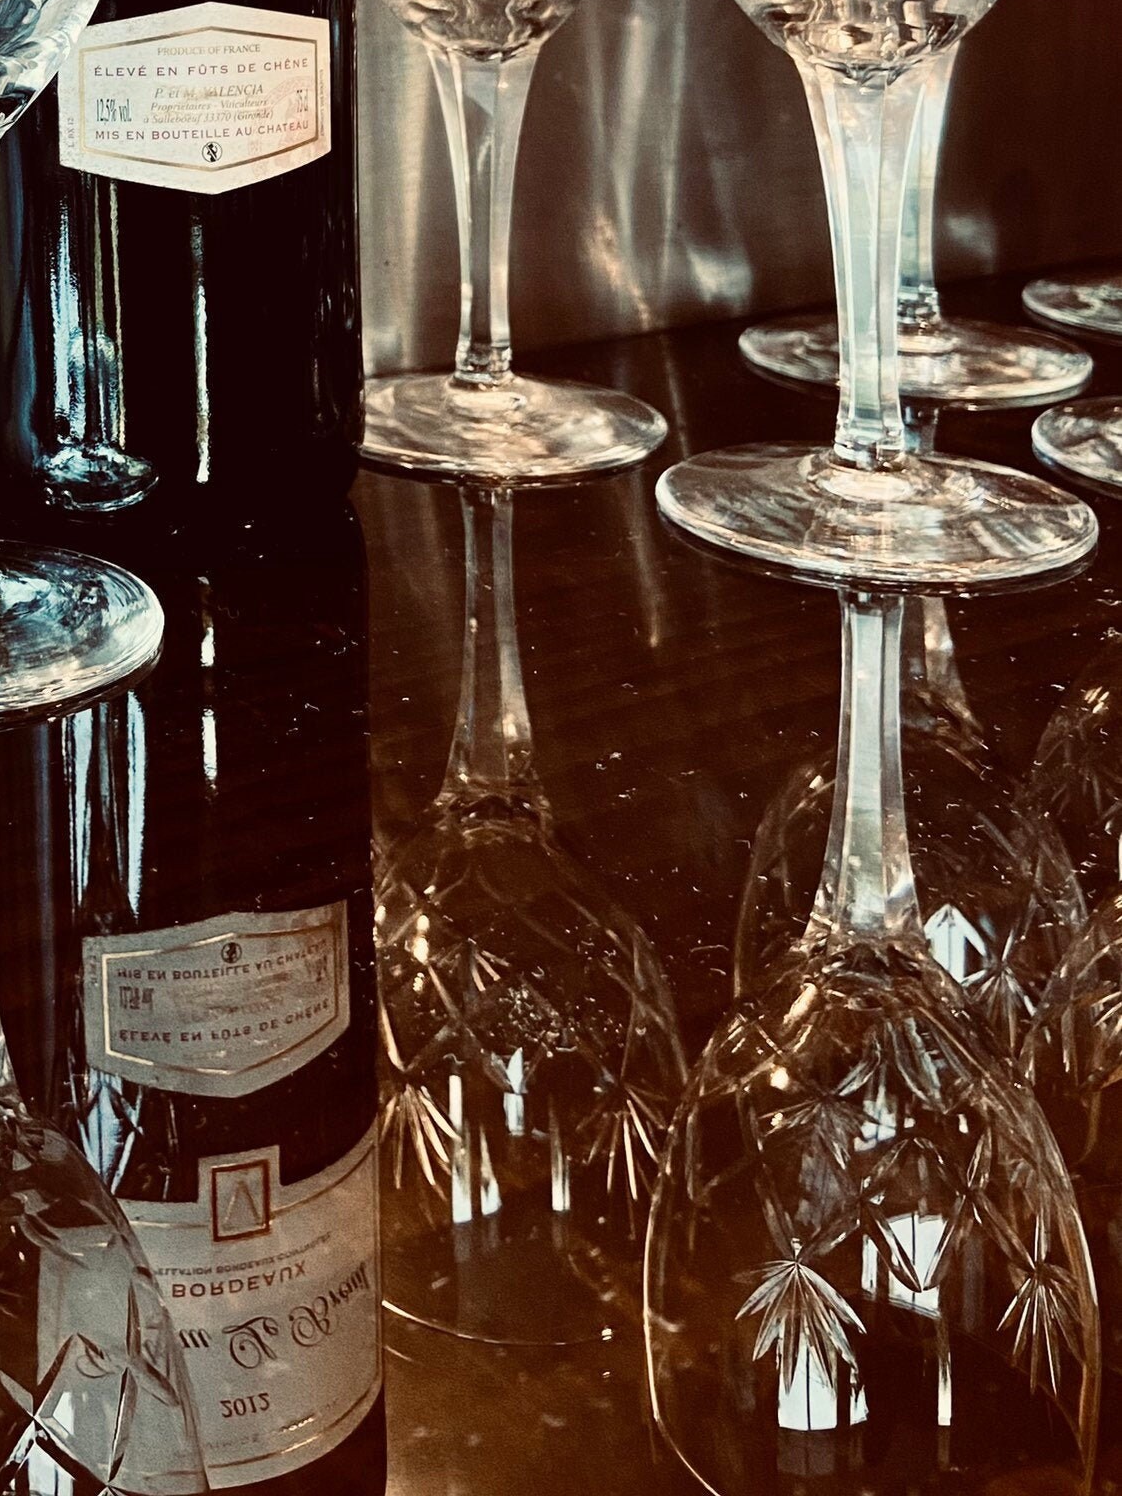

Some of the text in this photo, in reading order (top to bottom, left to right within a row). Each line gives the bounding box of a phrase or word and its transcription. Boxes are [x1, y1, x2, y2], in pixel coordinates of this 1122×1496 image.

[157, 44, 261, 57] PRODUCE OF FRANCE
[93, 58, 309, 77] ÉLEVÉ EN FÛTS DE CHÊNE
[95, 130, 120, 141] MIS
[126, 130, 145, 141] EN
[151, 128, 230, 140] BOUTEILLE
[235, 126, 253, 137] AU
